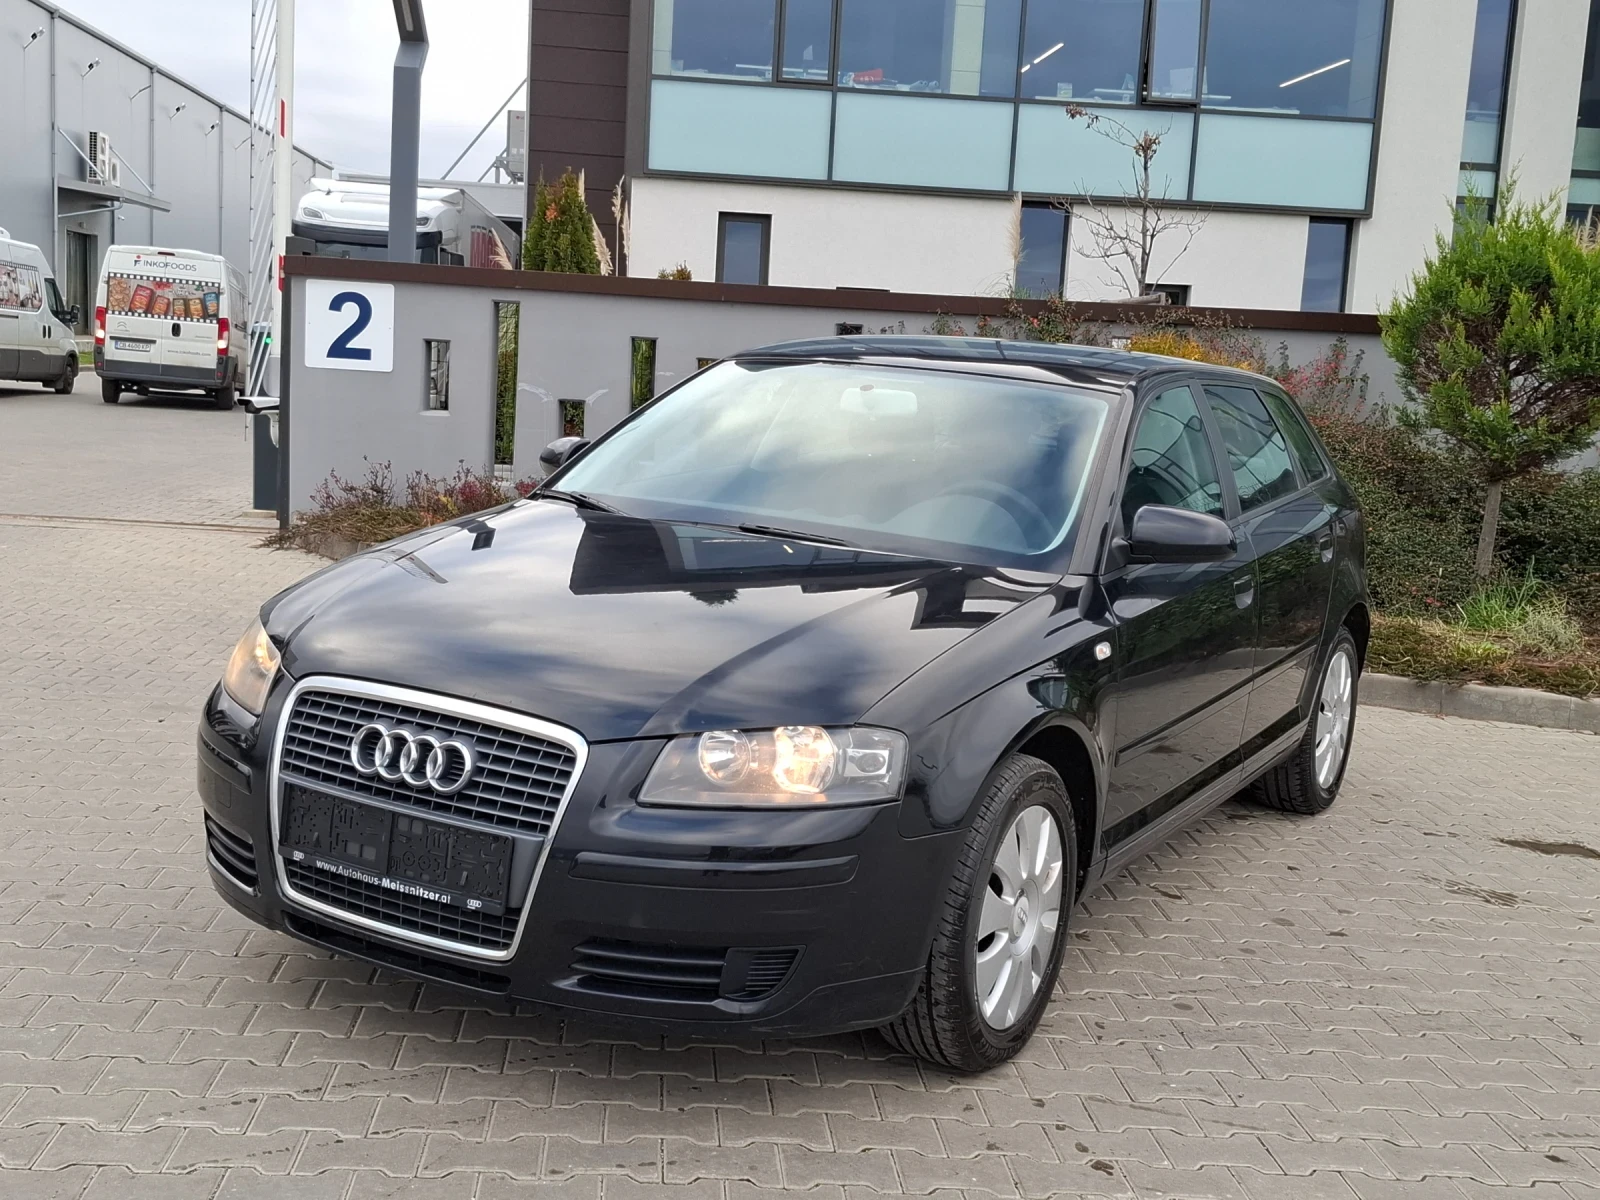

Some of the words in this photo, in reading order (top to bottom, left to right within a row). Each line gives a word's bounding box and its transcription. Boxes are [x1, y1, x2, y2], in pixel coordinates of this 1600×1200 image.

[144, 260, 197, 272] INKOFOODS
[326, 291, 373, 361] 2
[316, 859, 451, 904] www.Autohaus-Meissnitzer.at
